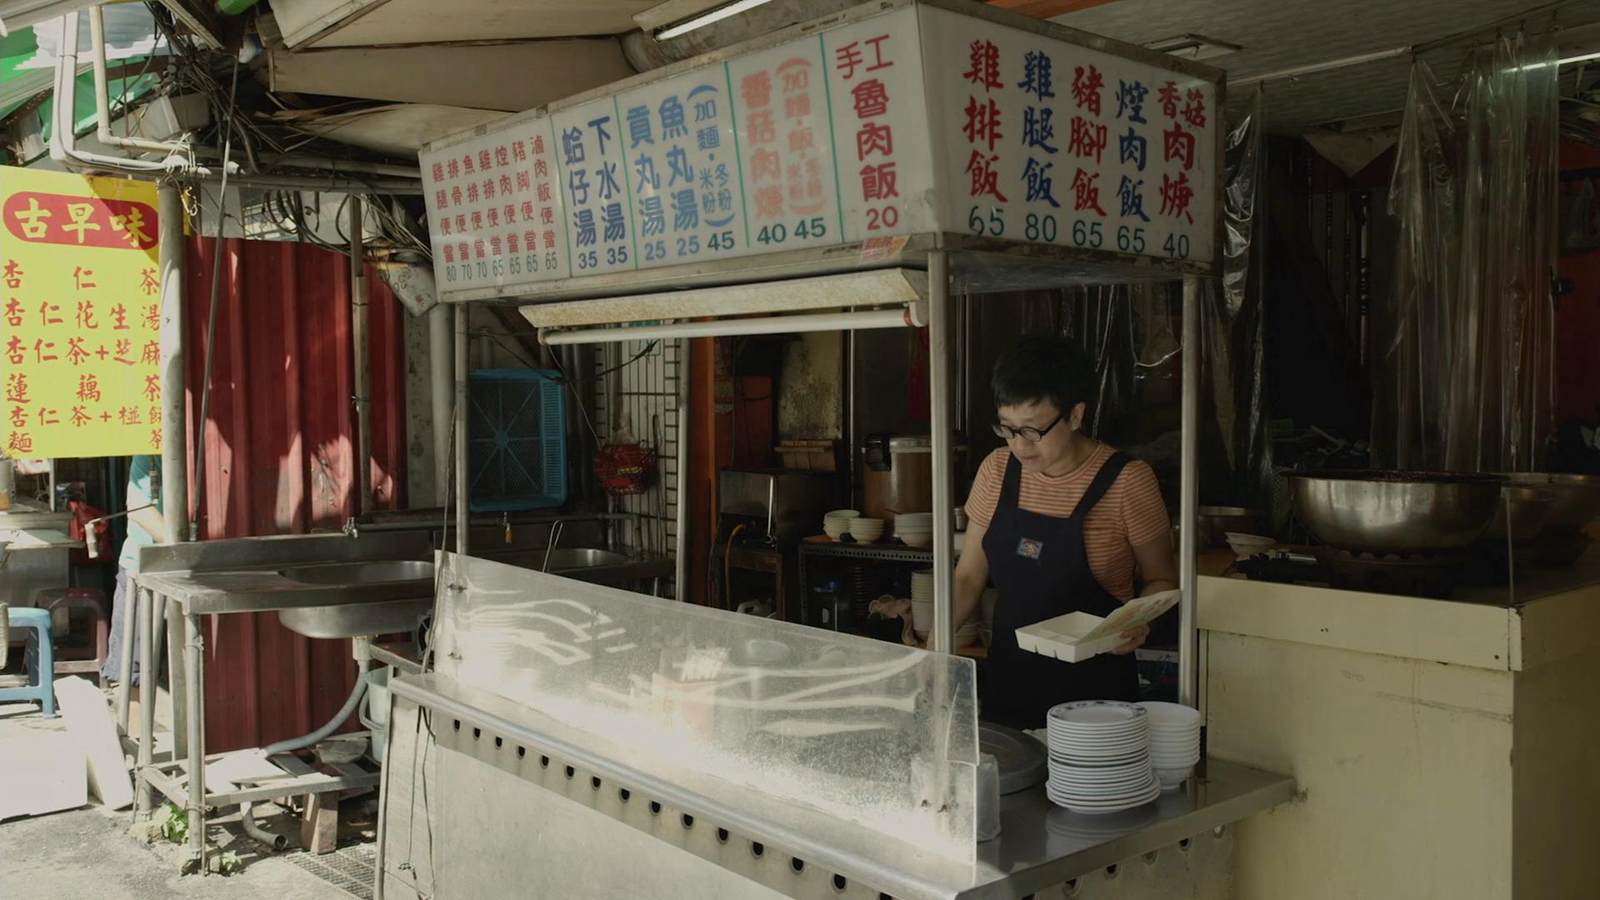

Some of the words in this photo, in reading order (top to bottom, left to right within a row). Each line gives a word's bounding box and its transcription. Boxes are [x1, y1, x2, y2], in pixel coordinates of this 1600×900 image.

[962, 39, 1009, 203] 雞排飯
[1017, 50, 1061, 209] 雞腿飯
[1067, 64, 1108, 217] 豬腳飯
[626, 104, 665, 238] 貢丸湯
[658, 95, 699, 232] 魚丸湯
[562, 125, 597, 248] 蛤仔湯
[587, 115, 626, 243] 下水湯
[432, 162, 454, 264] 雞腿便當
[447, 158, 470, 261] 排骨便當
[463, 155, 485, 259] 魚排便當
[478, 150, 502, 256] 雞排便當
[14, 197, 153, 248] 古早味
[794, 217, 827, 239] 45
[866, 206, 899, 231] 20
[968, 205, 1005, 236] 65
[1025, 213, 1057, 243] 80
[676, 235, 701, 257] 25
[707, 231, 735, 251] 45
[757, 223, 787, 245] 40
[1072, 220, 1103, 248] 65
[1117, 225, 1146, 254] 65
[1163, 233, 1190, 260] 40
[526, 254, 539, 272] 65
[545, 252, 558, 270] 65
[578, 250, 598, 269] 35
[607, 246, 628, 265] 35
[644, 241, 667, 261] 25
[446, 265, 457, 282] 80
[461, 263, 472, 280] 70
[476, 261, 488, 278] 70
[492, 260, 504, 277] 65
[509, 257, 521, 274] 65
[3, 297, 160, 331] 杏仁花生湯
